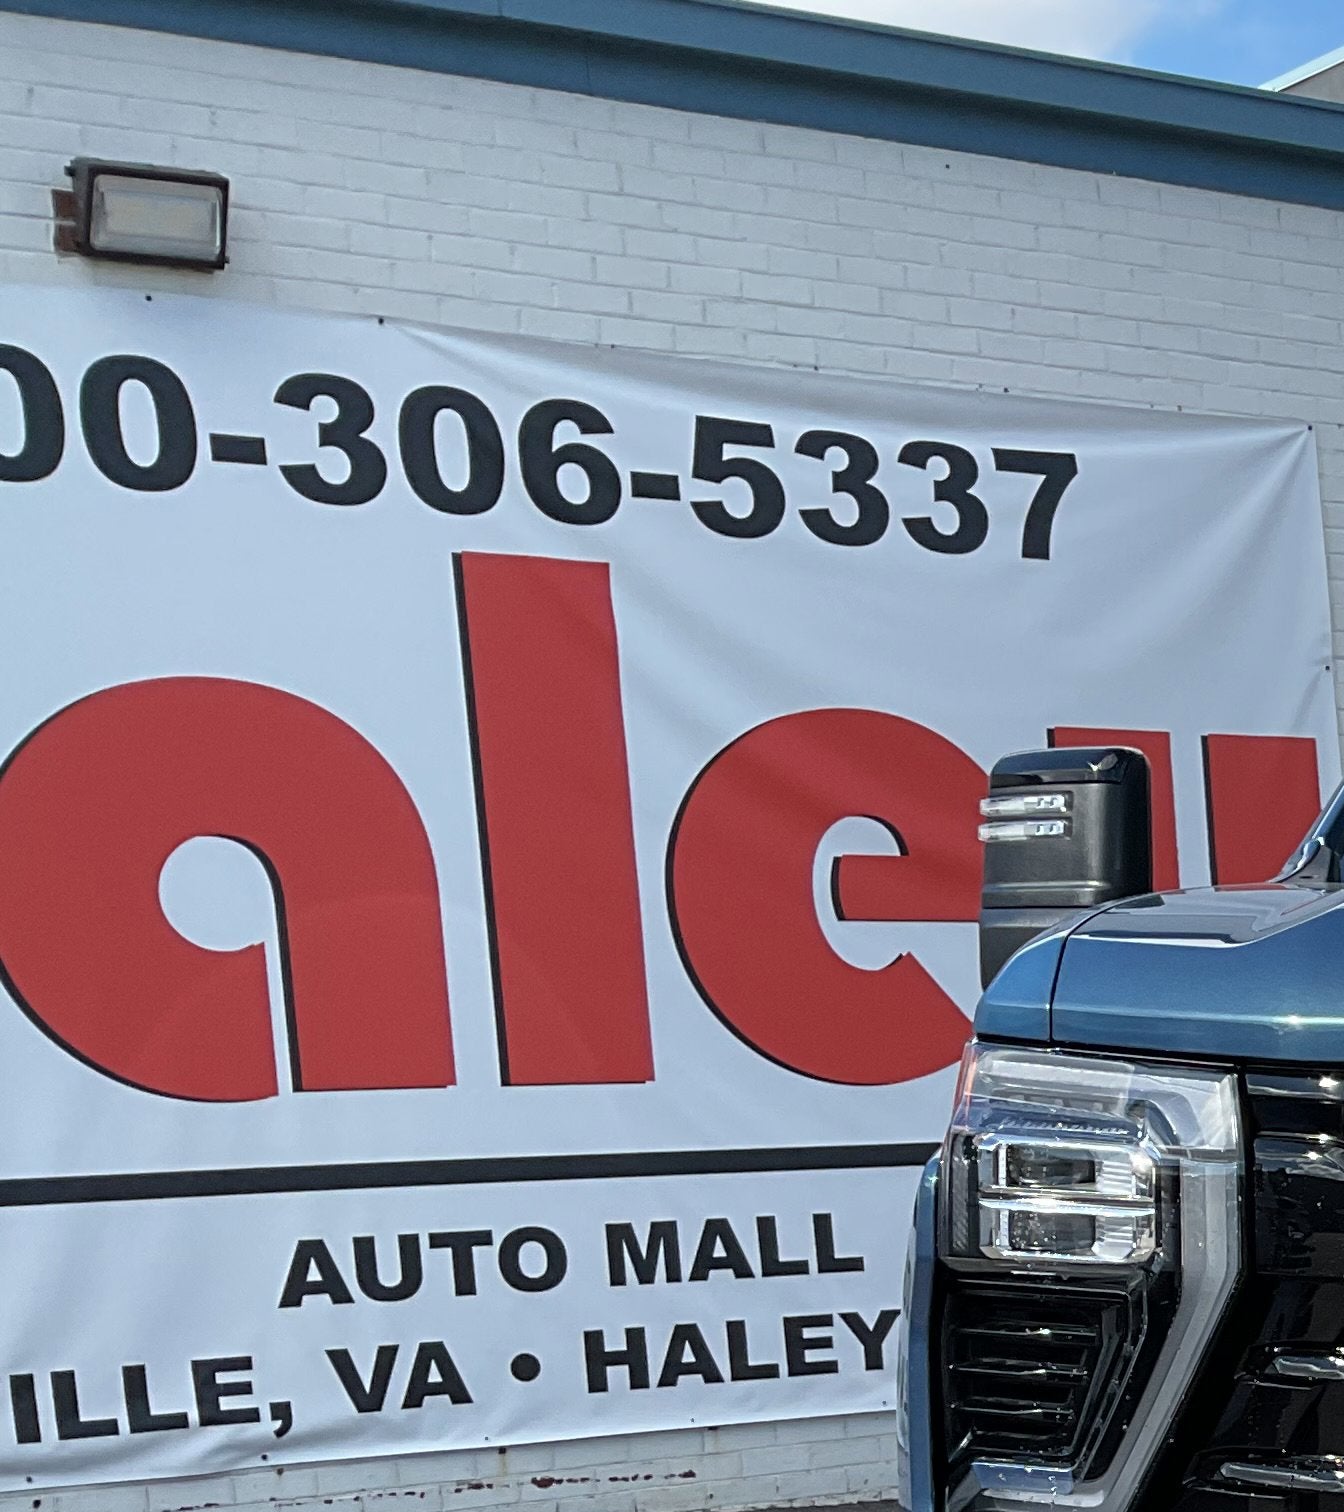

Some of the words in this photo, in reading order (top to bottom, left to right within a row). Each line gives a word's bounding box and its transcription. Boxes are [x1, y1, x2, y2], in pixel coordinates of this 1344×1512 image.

[278, 1226, 568, 1309] AUTO
[605, 1212, 865, 1287] MALL
[9, 1355, 293, 1444] ILLE,
[324, 1341, 474, 1414] VA
[583, 1309, 901, 1394] HALEY
